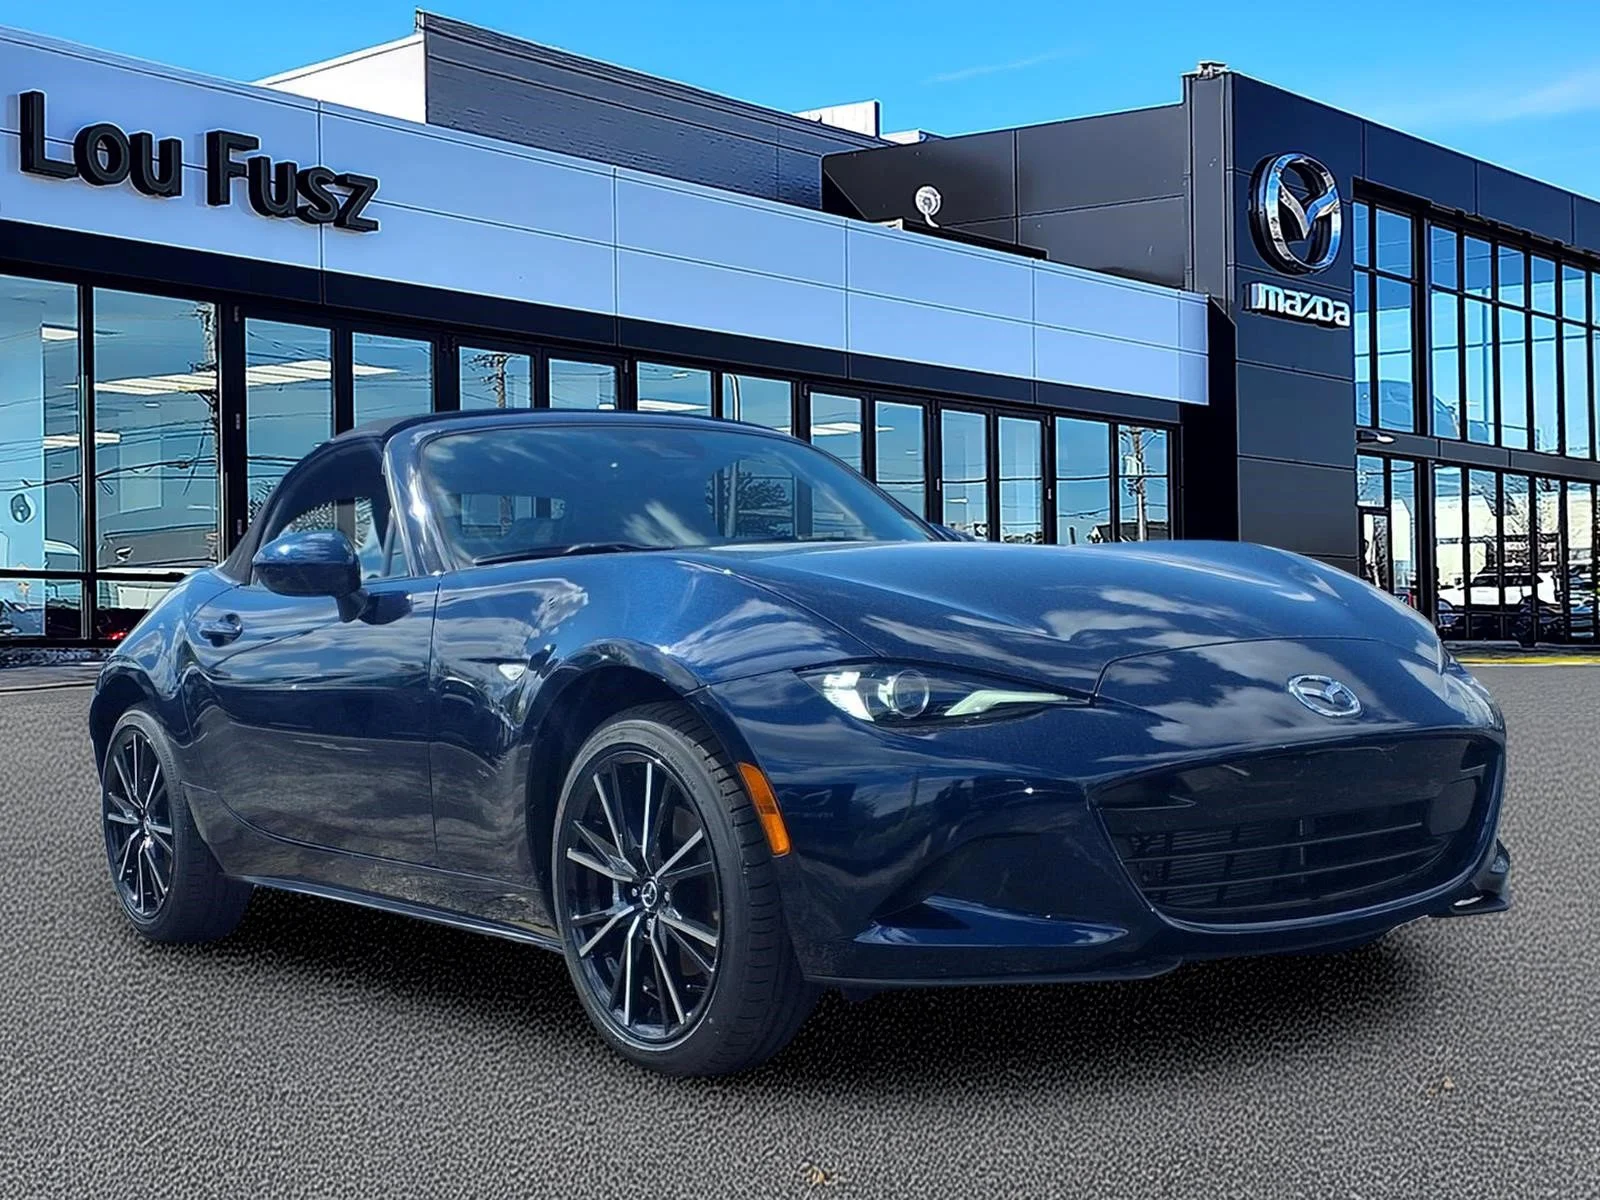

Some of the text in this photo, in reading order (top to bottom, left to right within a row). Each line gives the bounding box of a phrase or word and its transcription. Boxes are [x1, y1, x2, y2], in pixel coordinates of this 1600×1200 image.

[19, 90, 379, 232] Lou Fusz
[1250, 282, 1350, 327] mazda
